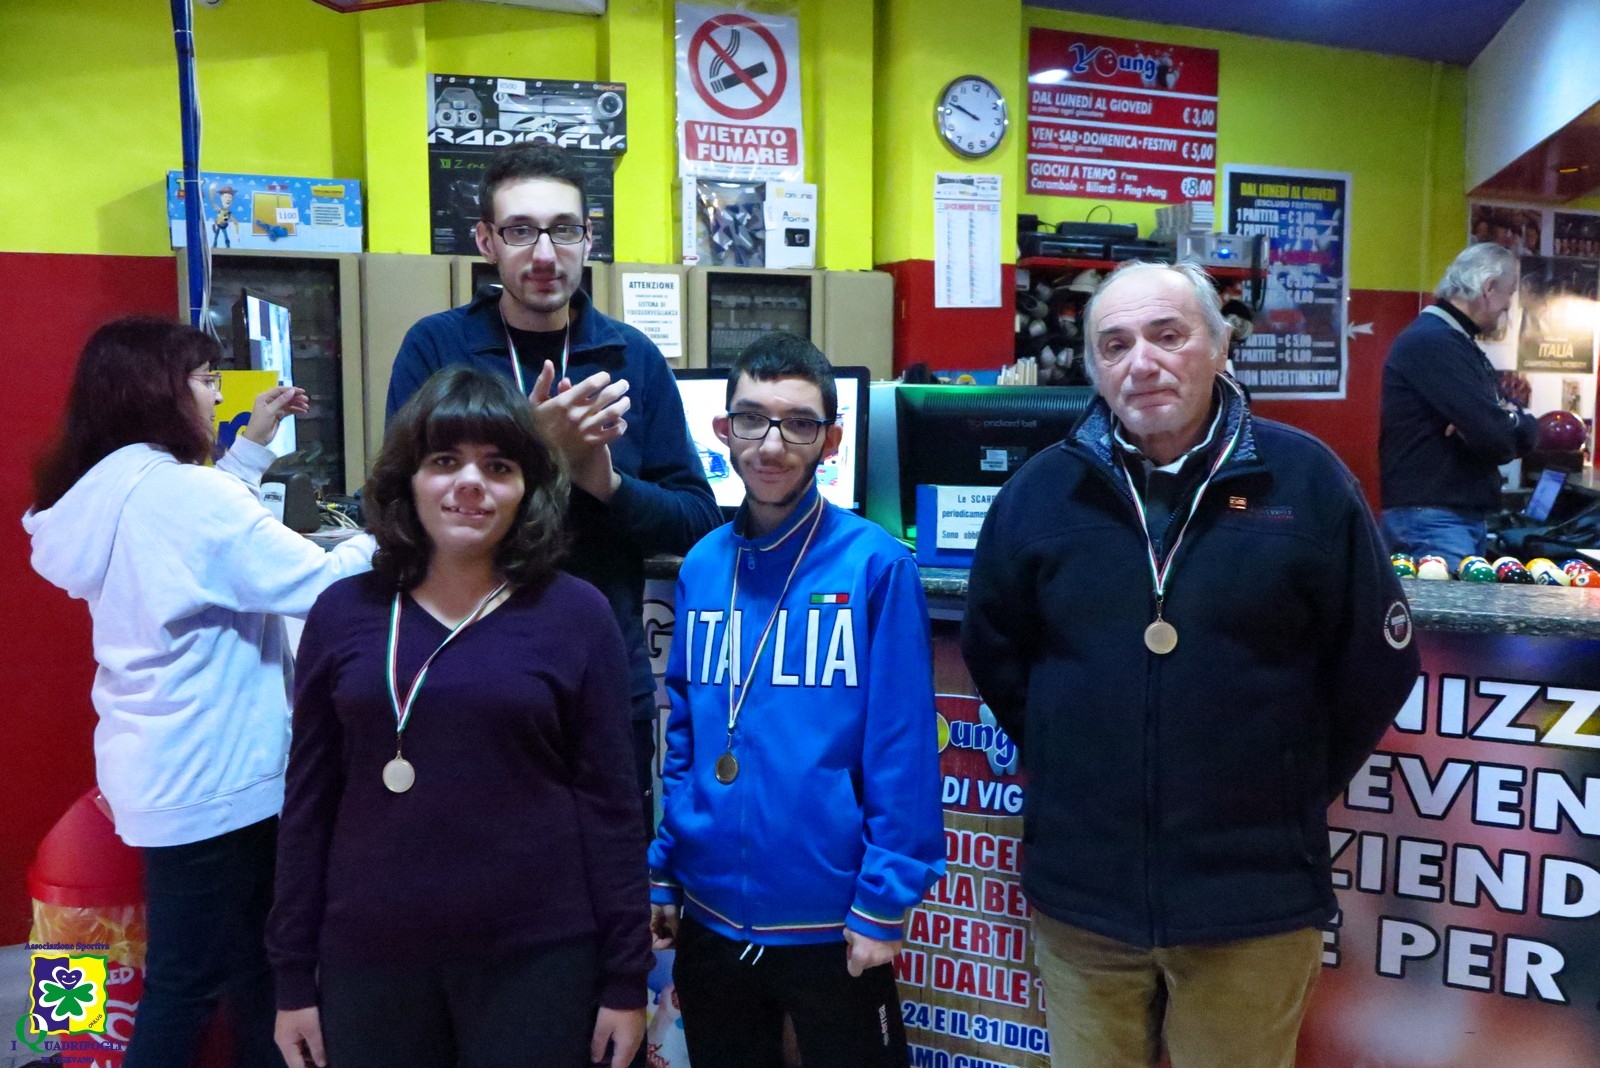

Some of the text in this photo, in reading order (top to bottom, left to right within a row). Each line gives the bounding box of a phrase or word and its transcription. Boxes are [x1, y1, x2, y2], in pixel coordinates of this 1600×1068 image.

[972, 84, 980, 92] 12
[1032, 91, 1052, 104] DAL
[1095, 98, 1107, 110] AL
[994, 118, 1001, 126] 3
[1182, 107, 1215, 127] € 3,00
[694, 123, 787, 146] VIETATO
[980, 140, 987, 148] 5
[697, 143, 789, 164] FUMARE
[968, 142, 974, 150] 6
[1182, 142, 1214, 161] € 5,00
[1031, 163, 1069, 179] GIOCHI
[1071, 167, 1080, 178] A
[1082, 166, 1117, 182] TEMPO
[1031, 178, 1077, 191] Carambole
[1086, 181, 1117, 194] Biliardi
[279, 211, 297, 220] 1100
[1237, 208, 1242, 220] 1
[1243, 208, 1279, 223] PARTITA
[629, 281, 674, 289] ATTENZIONE
[1241, 334, 1276, 347] ARTITA
[1233, 348, 1239, 361] 2
[1241, 349, 1276, 362] PARTITE
[1538, 343, 1574, 358] ITALIA
[958, 495, 967, 504] Le
[942, 530, 959, 539] Sono
[685, 608, 858, 687] ITALIA
[942, 775, 1023, 813] DI VIG
[943, 828, 1023, 873] DICE
[985, 879, 1032, 918] BE
[909, 910, 1025, 961] APERTI
[1379, 918, 1567, 1003] PER
[934, 956, 1028, 1005] DALLE
[903, 1002, 930, 1028] 24
[935, 1008, 946, 1031] E
[951, 1012, 969, 1036] IL
[974, 1016, 999, 1043] 31
